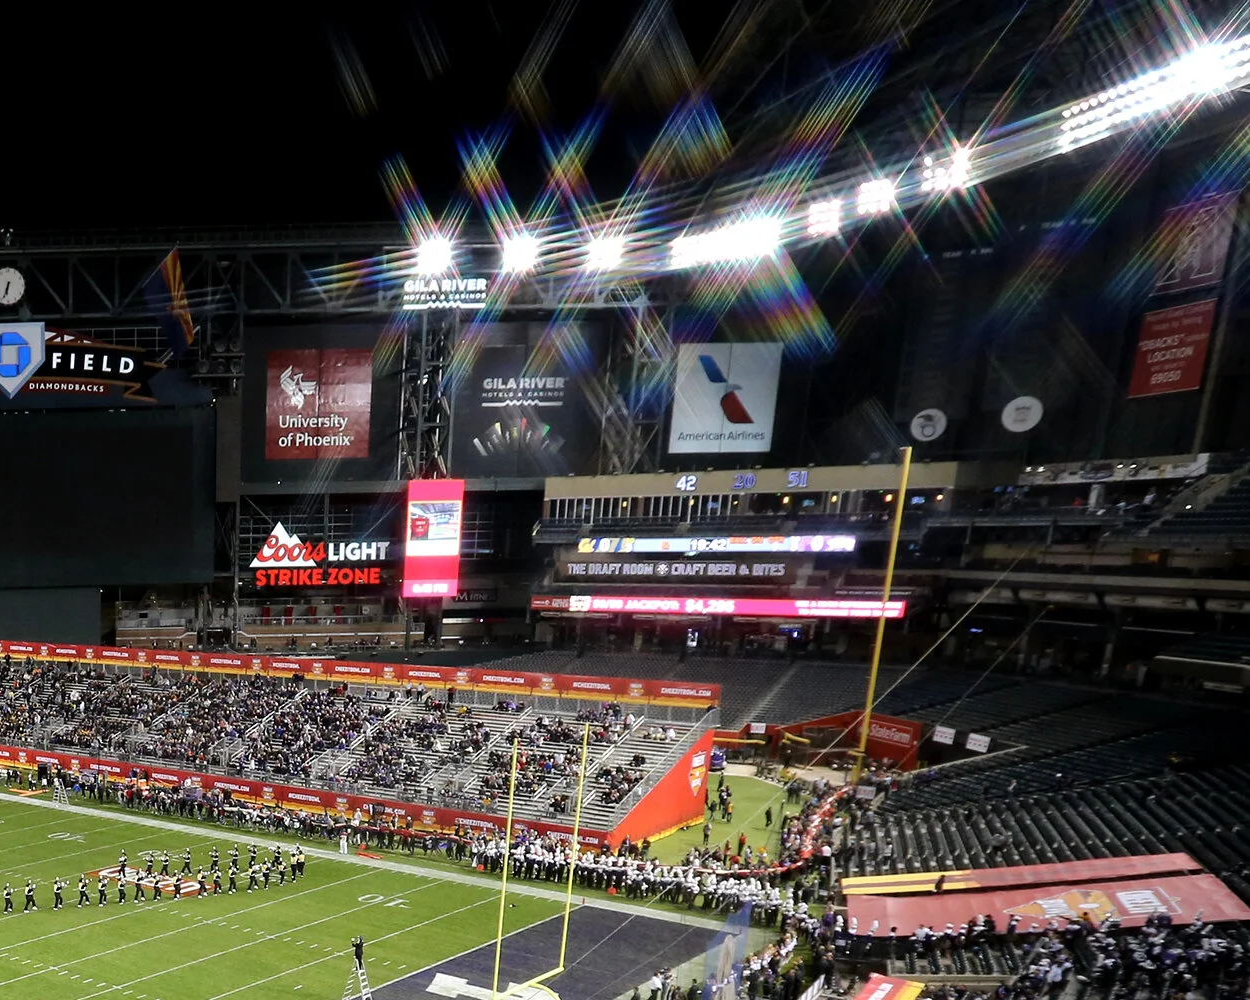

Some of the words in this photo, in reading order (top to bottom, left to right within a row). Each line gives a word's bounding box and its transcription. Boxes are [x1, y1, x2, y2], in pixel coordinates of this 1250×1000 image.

[404, 279, 438, 292] GILA
[441, 278, 487, 291] RIVER
[52, 352, 135, 374] FIELD
[29, 382, 105, 393] DIAMONDBACKS
[483, 378, 517, 390] GILA
[519, 377, 565, 389] RIVER
[279, 414, 348, 431] University
[279, 432, 294, 447] of
[296, 432, 350, 447] Phoenix
[678, 431, 726, 441] American
[727, 430, 765, 441] Airlines
[676, 475, 697, 491] 42
[732, 473, 756, 489] 20
[787, 470, 809, 487] 51
[256, 534, 328, 562] Coors
[328, 541, 390, 562] LIGHT
[255, 568, 324, 587] STRIKE
[327, 567, 381, 585] ZONE
[567, 563, 587, 575] THE
[588, 563, 622, 575] DRAFT
[623, 563, 654, 575] ROOM
[671, 563, 706, 575] CRAFT
[707, 563, 737, 575] BEER
[752, 563, 786, 576] BITES
[870, 723, 911, 745] StateFarm
